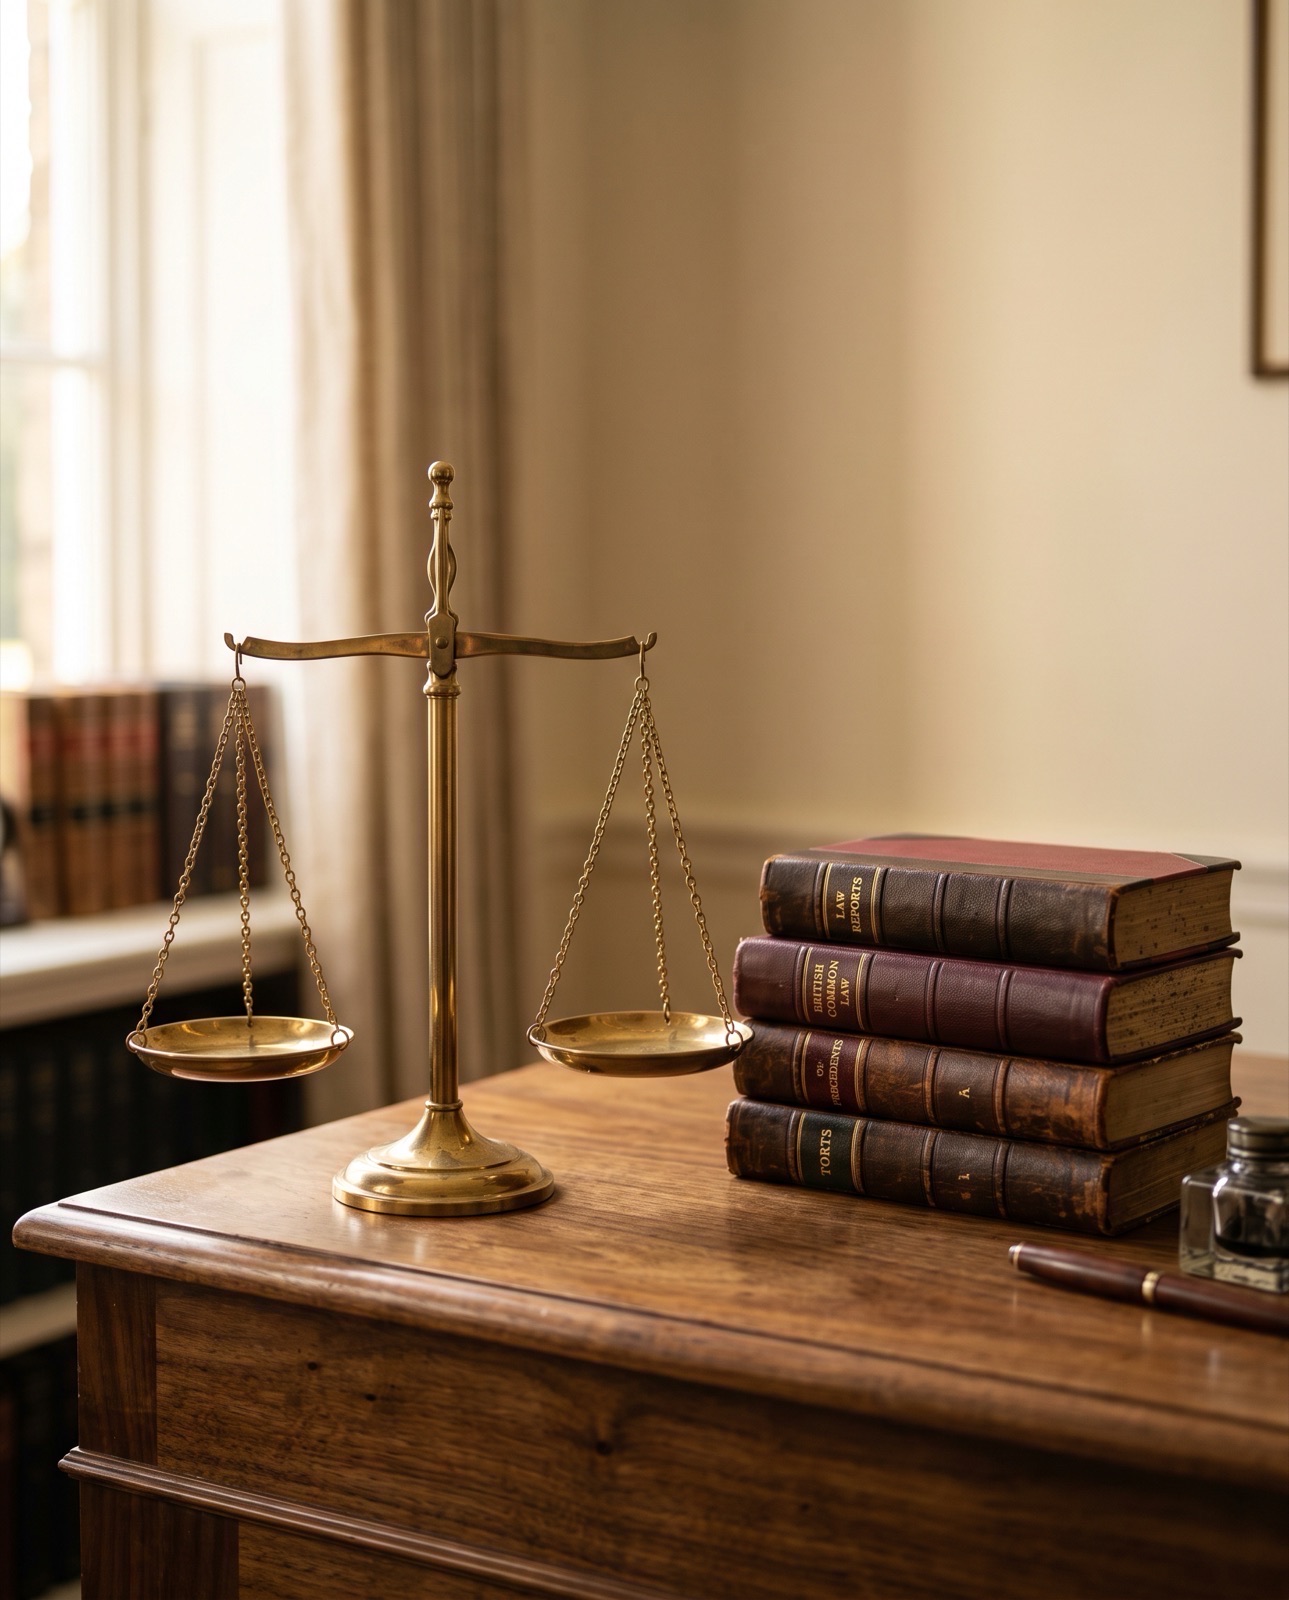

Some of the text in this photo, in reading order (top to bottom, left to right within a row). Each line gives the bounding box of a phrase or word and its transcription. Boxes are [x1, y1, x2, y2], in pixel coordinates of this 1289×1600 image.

[835, 891, 845, 918] LAW
[851, 876, 863, 933] REPORTS
[813, 963, 825, 1013] BRITISH
[827, 960, 840, 1018] COMMON
[840, 978, 850, 1007] LAW
[829, 1039, 844, 1106] PRECEDENTS
[820, 1129, 832, 1176] TORTS
